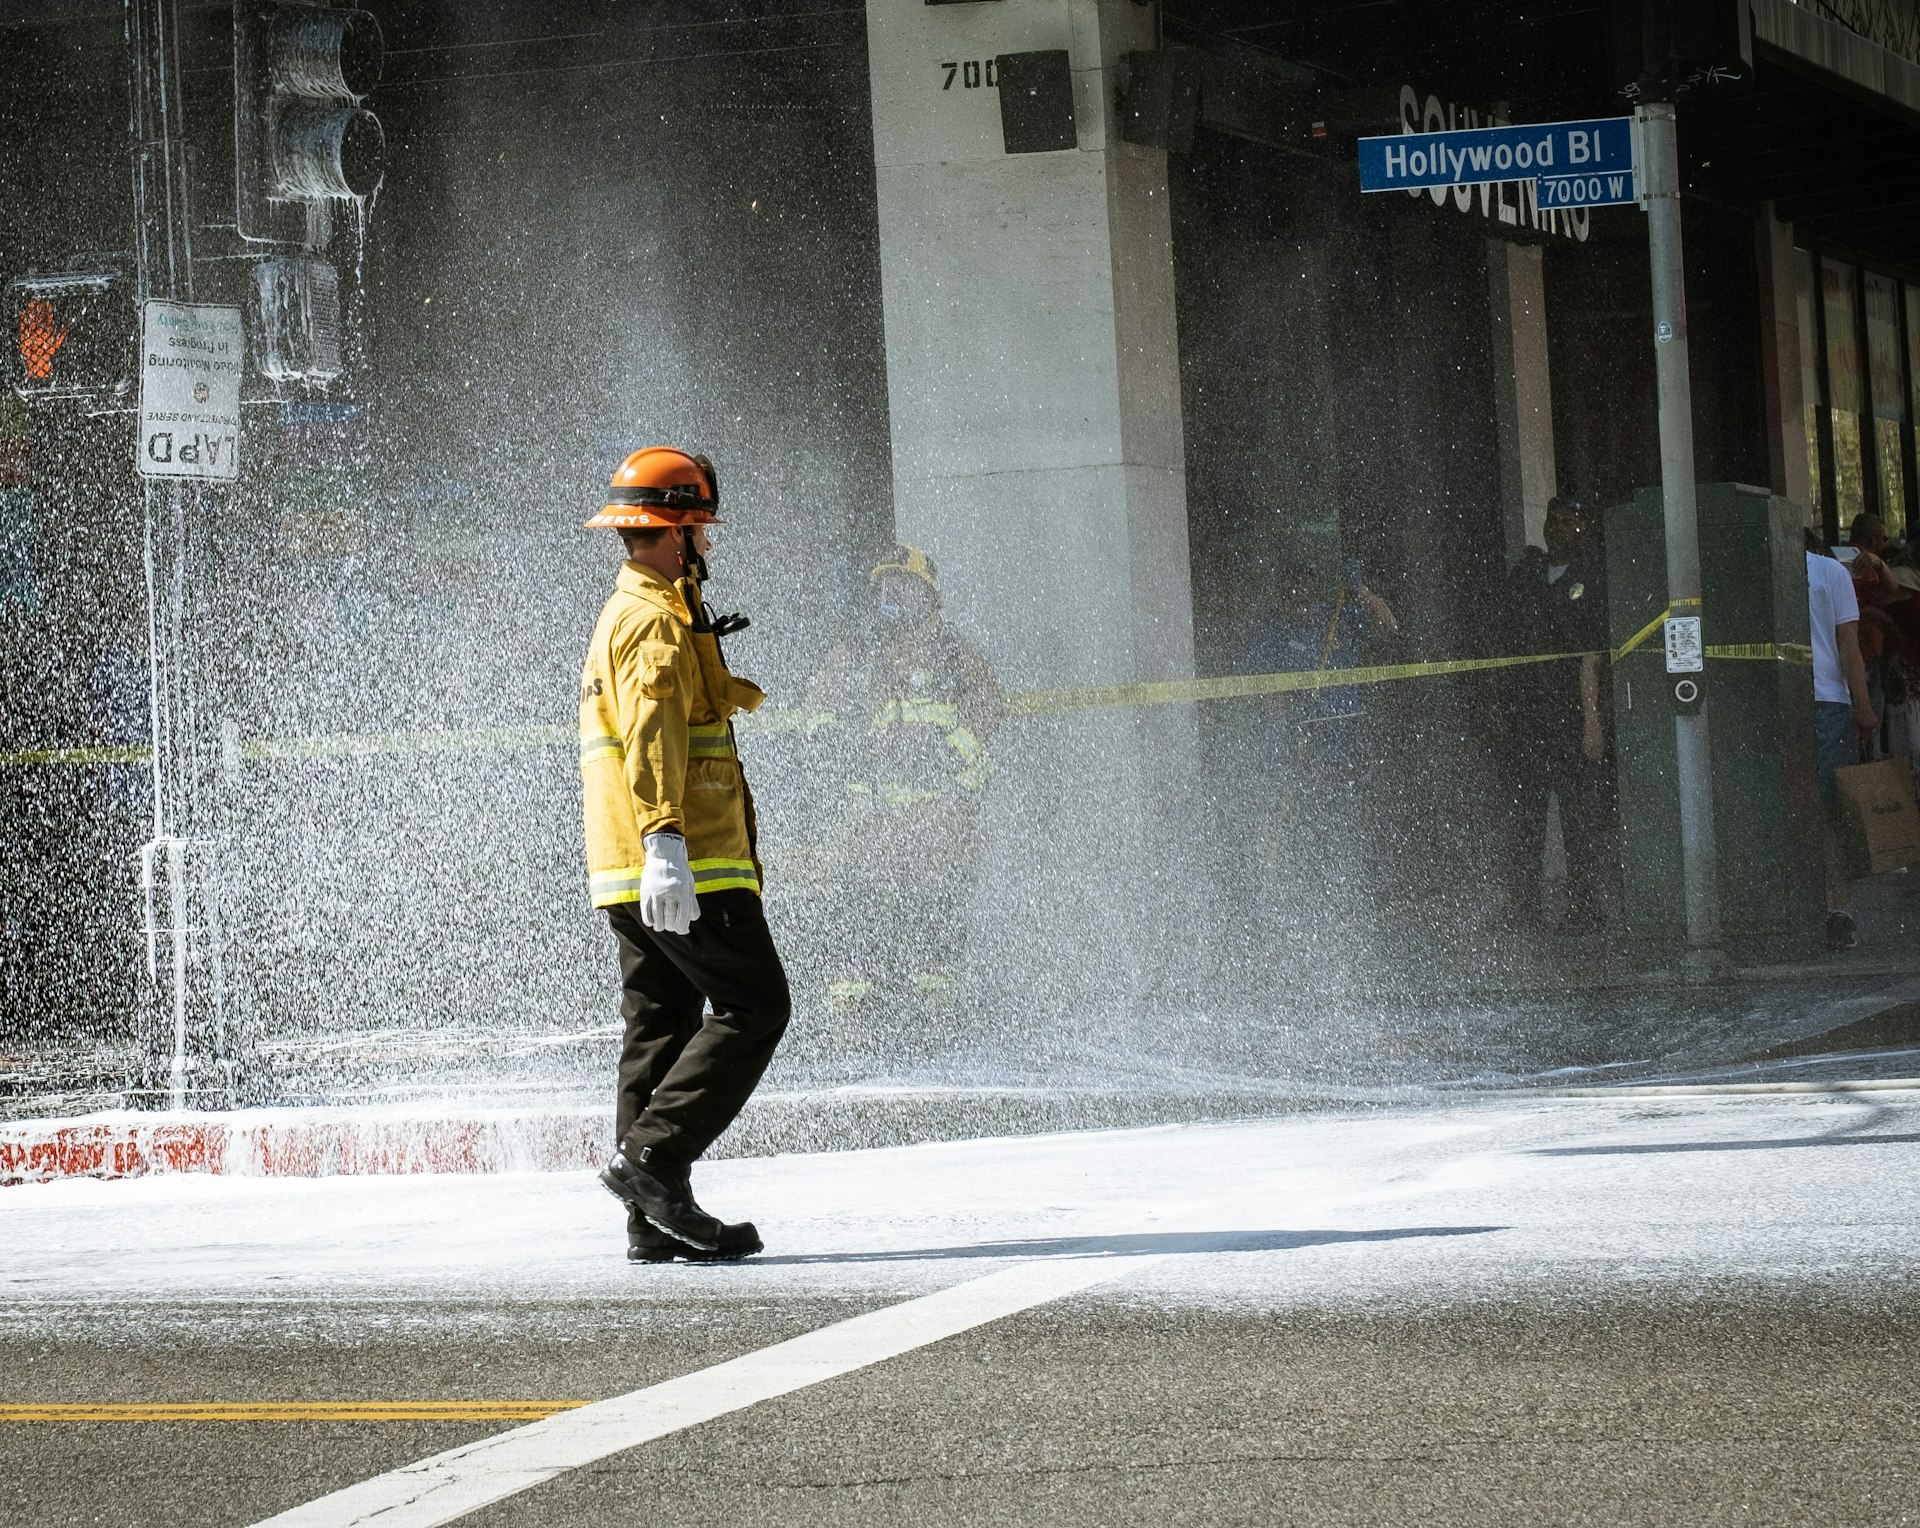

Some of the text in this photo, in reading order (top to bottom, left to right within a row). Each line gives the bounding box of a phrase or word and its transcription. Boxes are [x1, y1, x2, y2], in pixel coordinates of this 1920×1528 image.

[1385, 129, 1601, 181] Hollywood Bl
[1545, 176, 1624, 203] 7000 W
[146, 412, 179, 422] SERVE
[148, 432, 236, 467] LAPD
